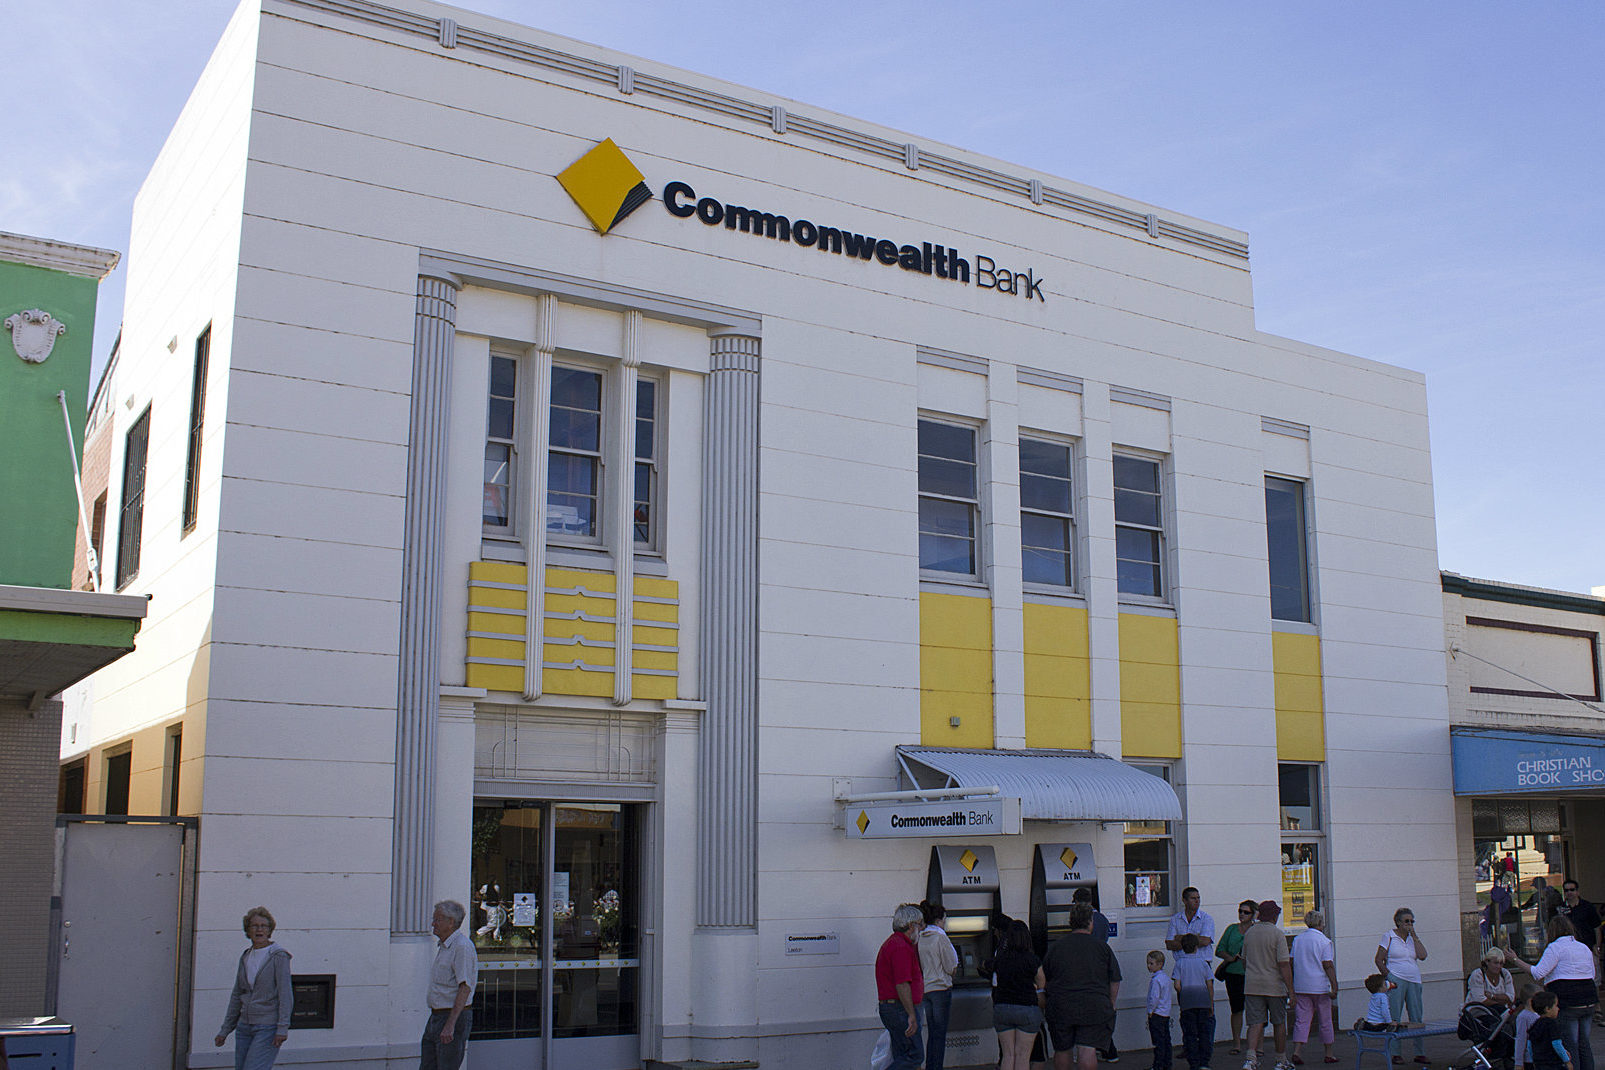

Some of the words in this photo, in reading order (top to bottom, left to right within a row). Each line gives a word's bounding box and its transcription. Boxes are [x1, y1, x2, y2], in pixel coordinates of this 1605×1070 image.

[663, 181, 969, 283] Commonwealth
[976, 255, 1045, 302] Bank
[1517, 756, 1592, 773] CHRISTIAN
[1518, 772, 1561, 786] BOOK
[1572, 769, 1605, 783] SHO
[891, 811, 966, 828] Commonwealth
[968, 810, 994, 825] Bank
[962, 876, 981, 885] ATM
[1063, 872, 1081, 881] ATM
